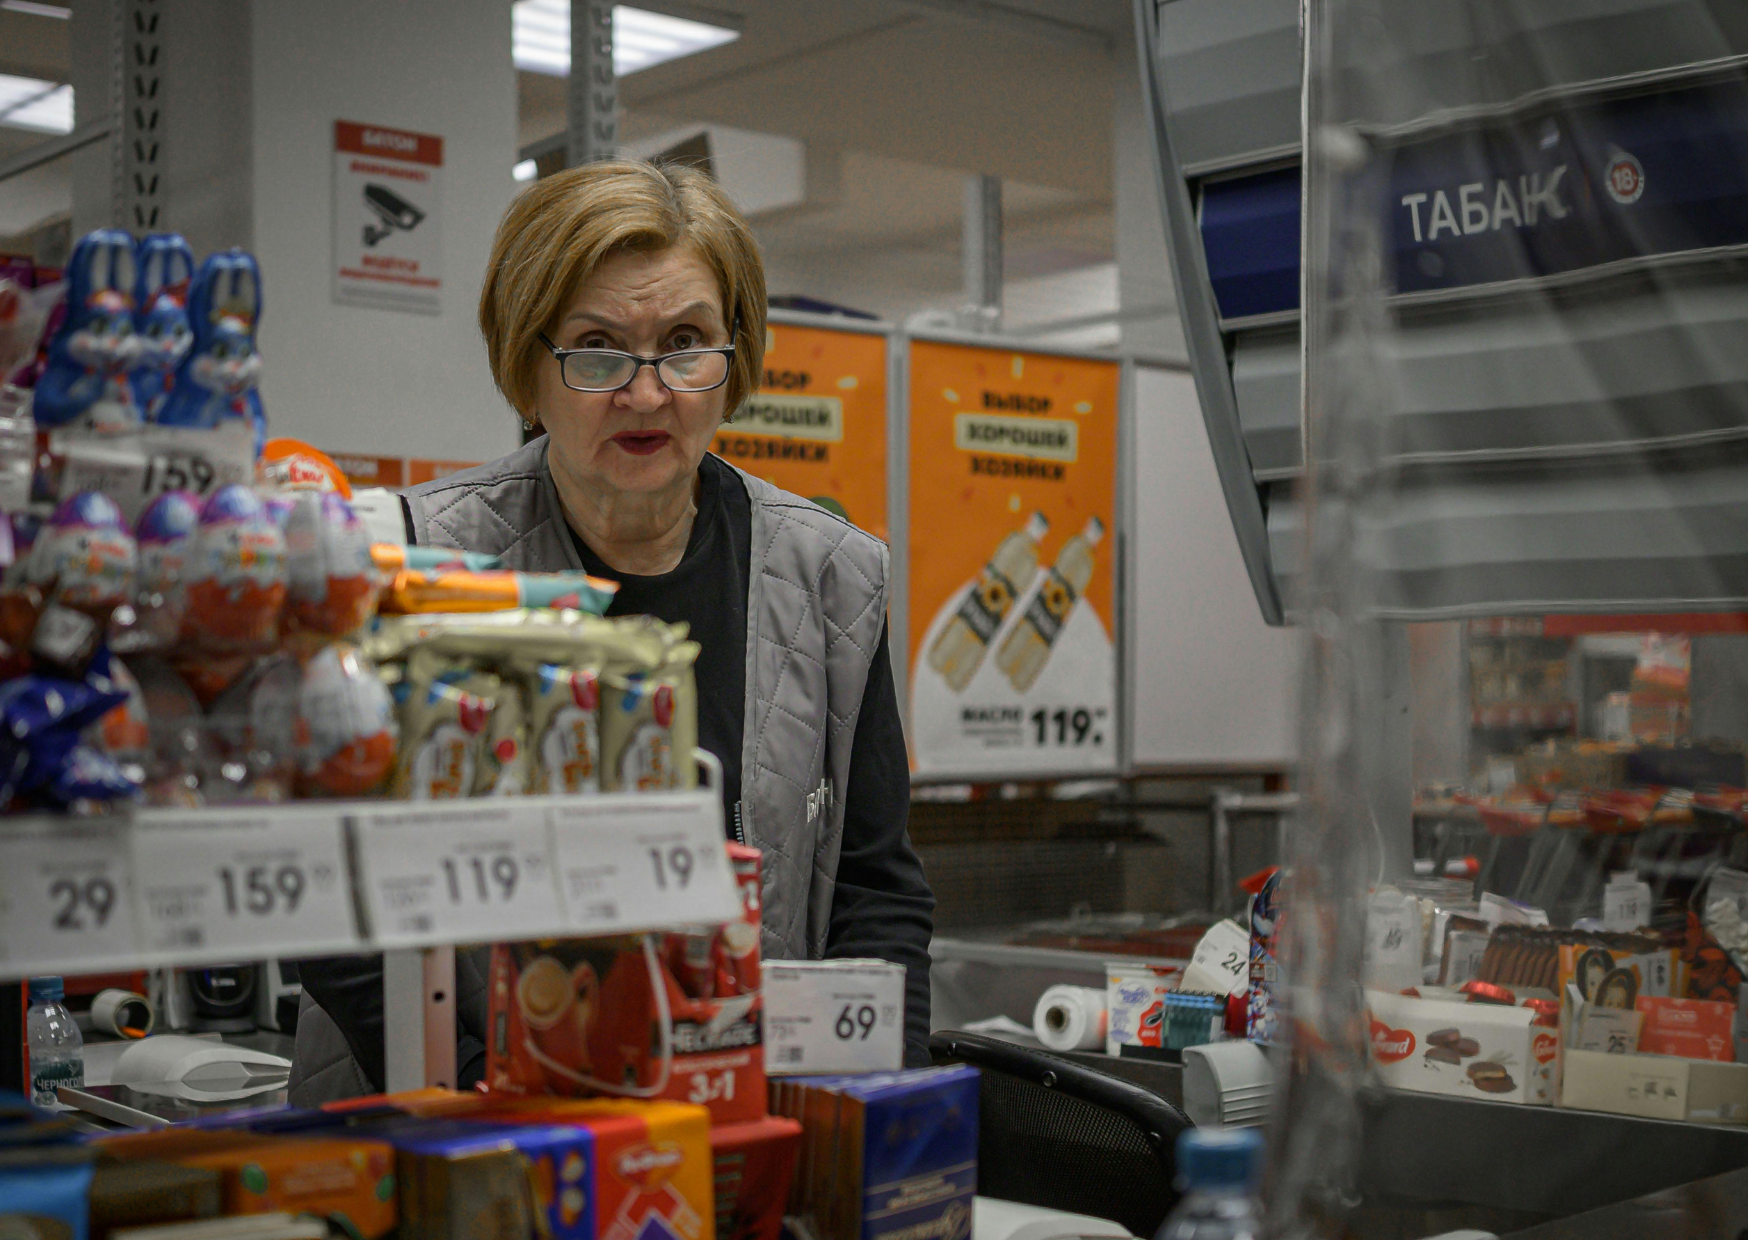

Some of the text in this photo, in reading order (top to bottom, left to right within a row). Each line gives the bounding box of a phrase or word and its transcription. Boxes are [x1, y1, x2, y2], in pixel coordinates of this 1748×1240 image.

[1402, 165, 1568, 242] ТАБАК
[982, 390, 1052, 414] ВЫБОР
[968, 421, 1069, 449] ХОРОШЕЙ
[141, 459, 214, 494] 159
[971, 455, 1066, 482] ХОЗЯЙКИ
[442, 855, 519, 903] 119
[648, 846, 694, 889] 19
[48, 877, 116, 931] 29
[217, 865, 305, 916] 159
[1221, 952, 1247, 976] 24
[835, 1003, 877, 1041] 69
[37, 1077, 82, 1091] ЧЕРНОГО
